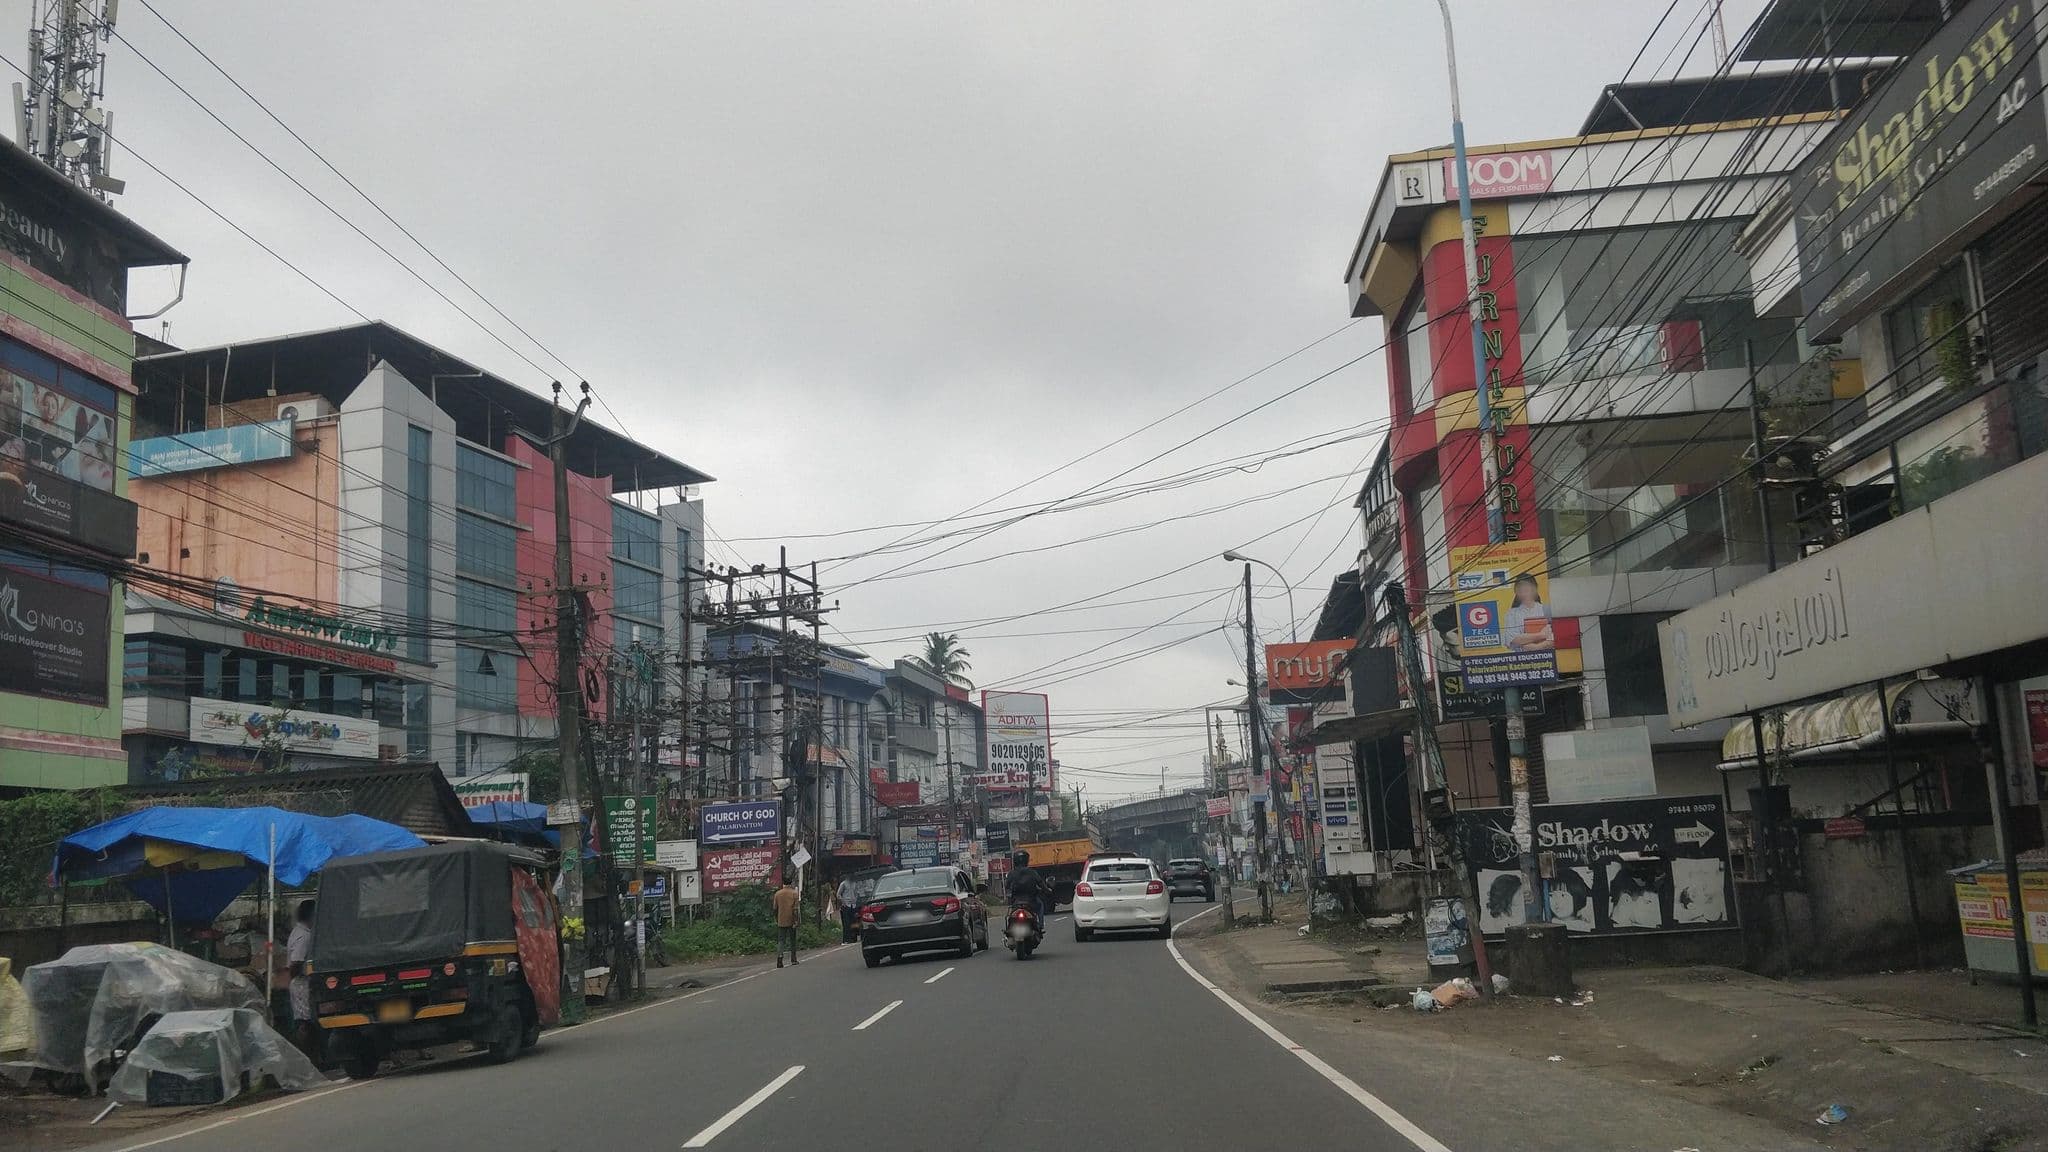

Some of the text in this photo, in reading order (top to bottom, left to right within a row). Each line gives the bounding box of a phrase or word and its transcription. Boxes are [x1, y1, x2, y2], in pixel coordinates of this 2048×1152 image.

[1996, 77, 2029, 125] AC
[1459, 578, 1478, 588] SAP
[1469, 607, 1489, 625] G
[18, 635, 57, 651] Makeover
[58, 645, 84, 657] Studio
[1484, 655, 1518, 665] COMPUTER
[1518, 652, 1553, 662] EDUCATION
[998, 714, 1037, 726] ADITYA
[962, 772, 1034, 786] MOBILE KIN
[705, 808, 776, 823] CHURCH OF GOD
[1327, 817, 1346, 825] vivo
[717, 821, 764, 831] PALARIVATTOM
[1537, 818, 1653, 848] Shadow
[1686, 830, 1710, 839] FLOOR
